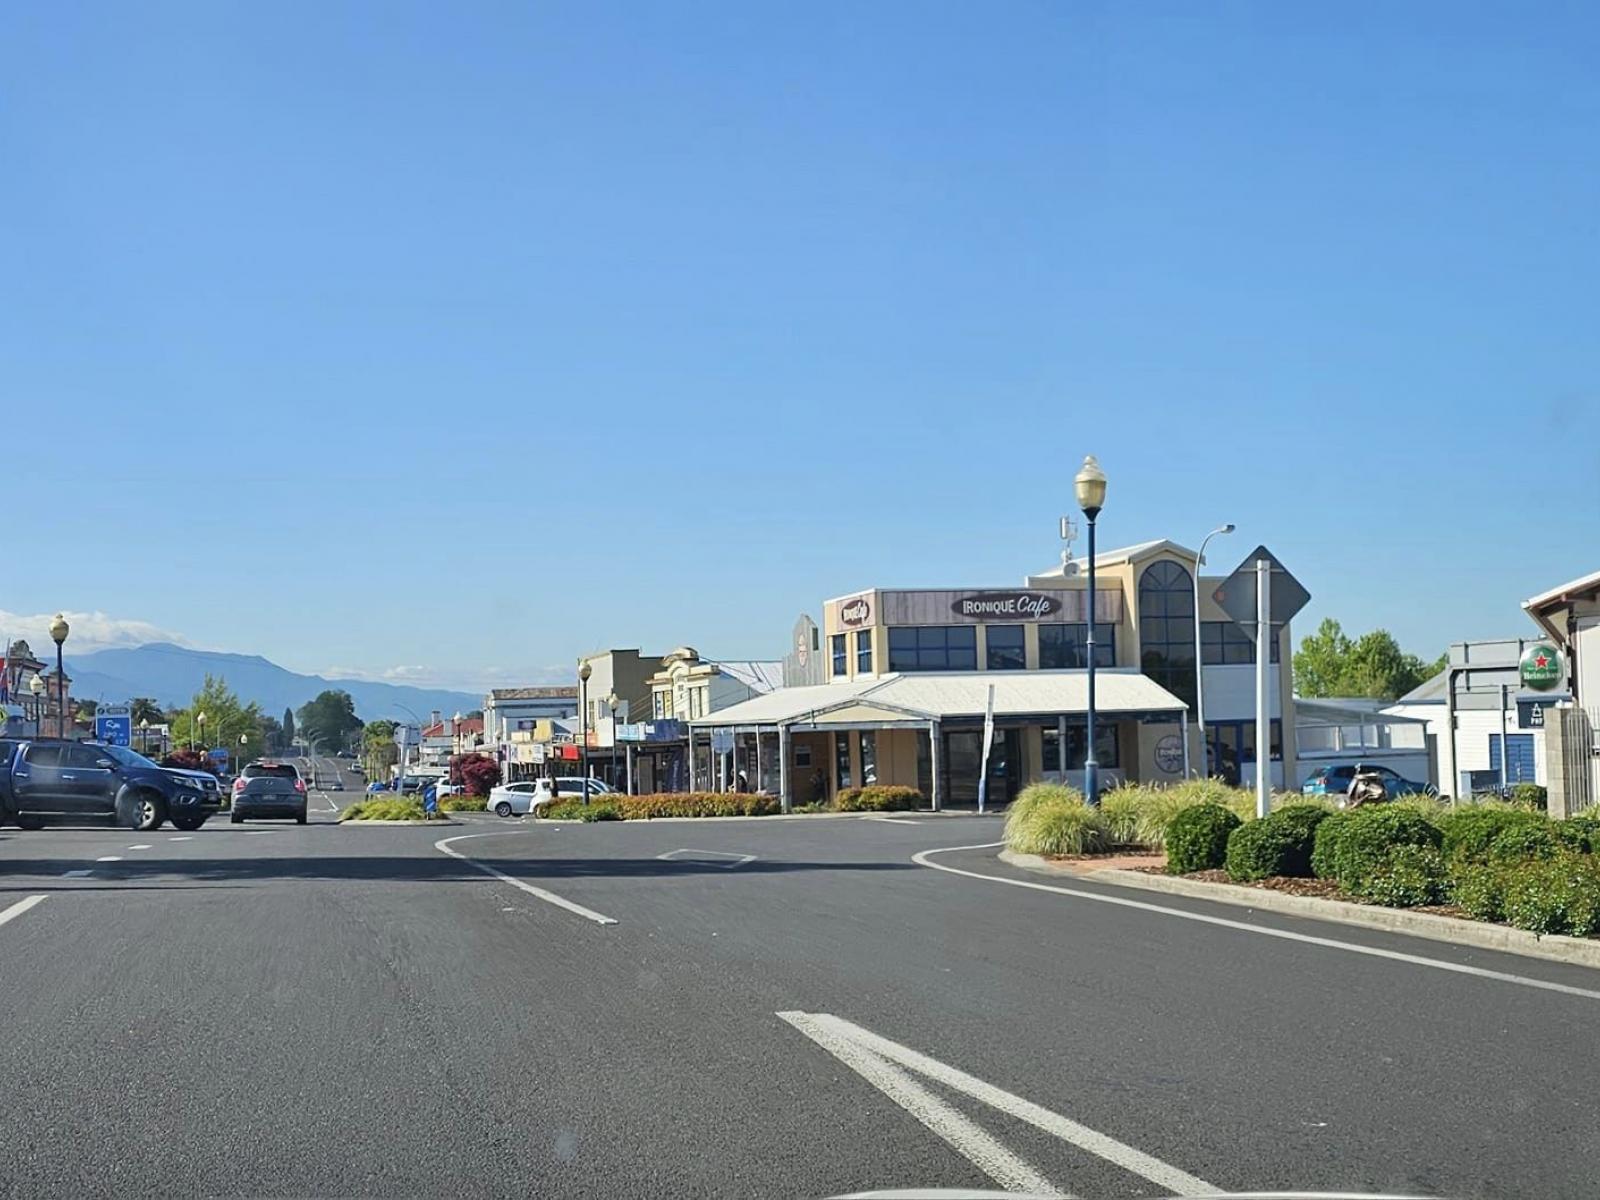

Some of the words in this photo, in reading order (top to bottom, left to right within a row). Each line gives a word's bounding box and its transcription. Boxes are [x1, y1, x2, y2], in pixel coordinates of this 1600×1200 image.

[963, 600, 1015, 614] IRONIQUE
[1017, 596, 1049, 619] Cafe
[1523, 671, 1561, 680] Heineken
